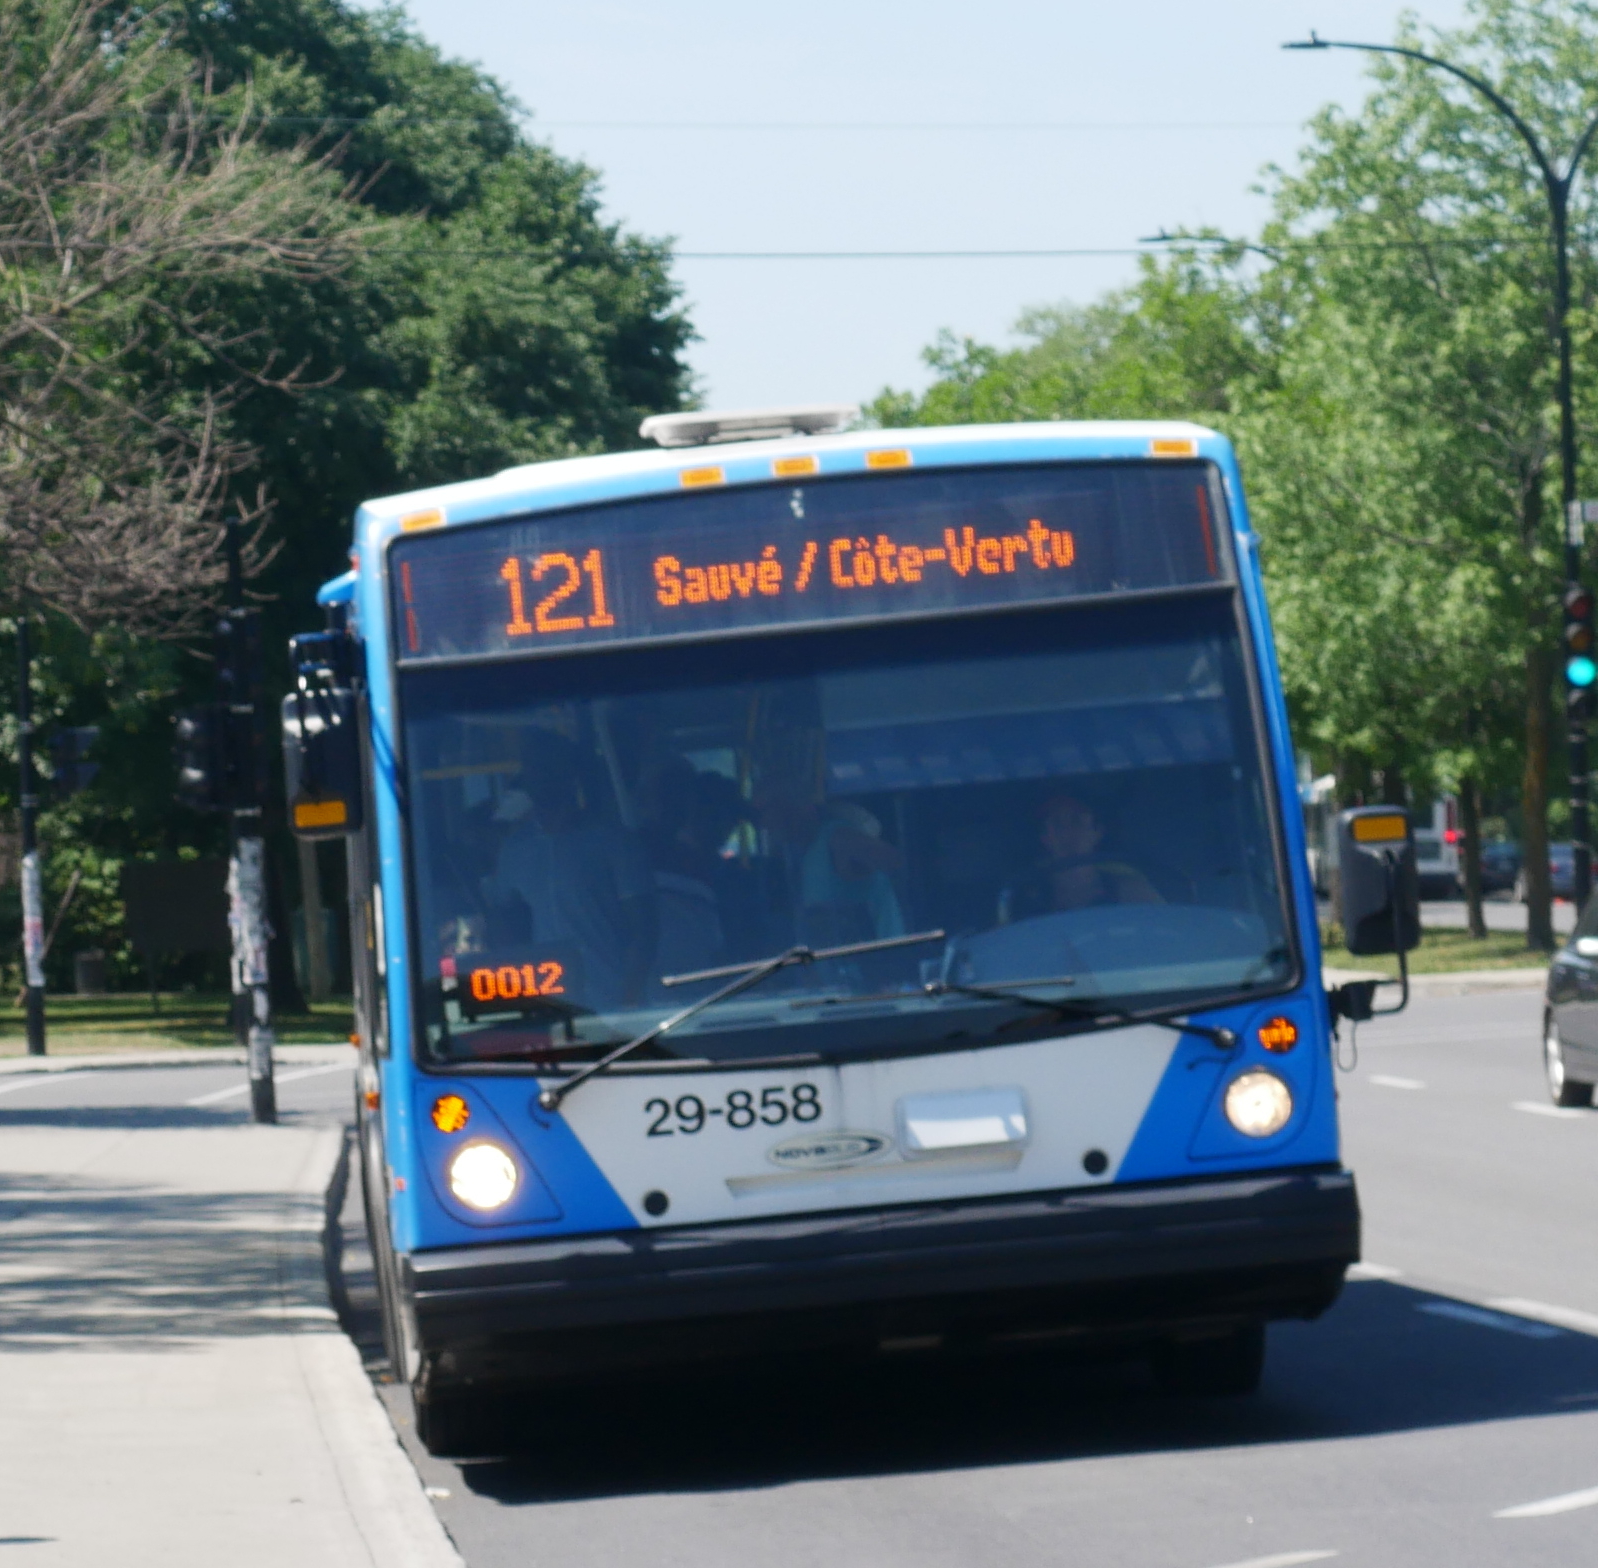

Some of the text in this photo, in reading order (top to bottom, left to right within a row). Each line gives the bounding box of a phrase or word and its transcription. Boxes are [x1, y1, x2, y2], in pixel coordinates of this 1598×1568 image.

[500, 549, 615, 636] 121
[654, 544, 783, 606] Sauvé
[828, 518, 1074, 588] Côte-Vertu
[470, 961, 565, 1002] 0012
[644, 1082, 822, 1138] 29-858
